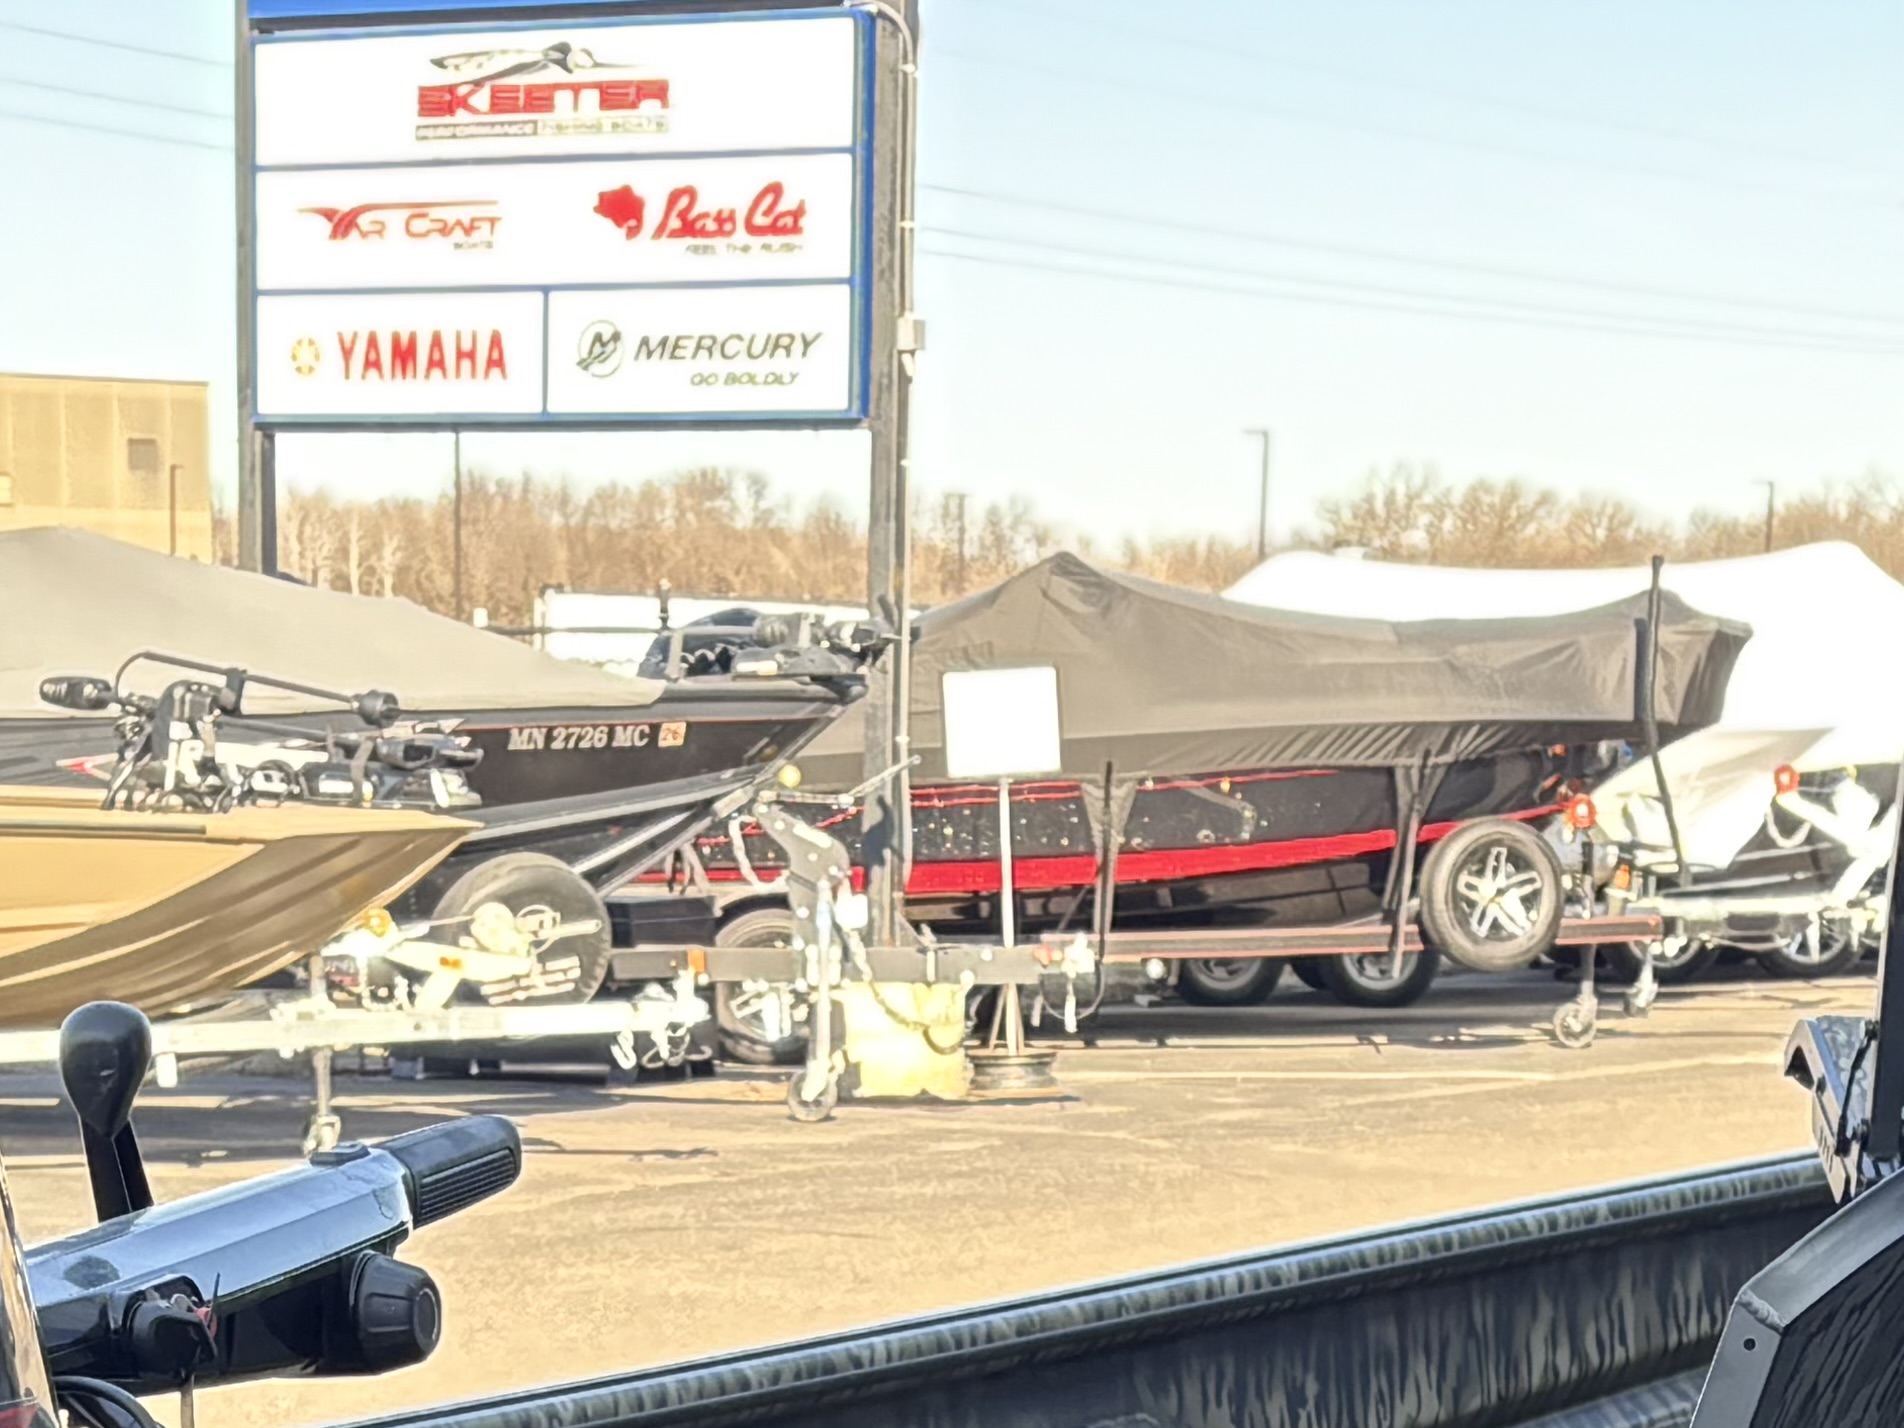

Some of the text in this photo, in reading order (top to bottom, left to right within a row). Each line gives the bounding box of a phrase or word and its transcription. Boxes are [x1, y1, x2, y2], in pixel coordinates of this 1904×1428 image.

[417, 79, 670, 118] SKEETER
[745, 181, 807, 237] Cat
[337, 328, 508, 381] YAMAHA
[634, 332, 824, 361] MERCURY
[507, 727, 548, 751] MN
[550, 726, 610, 750] 2726
[611, 725, 651, 748] MC
